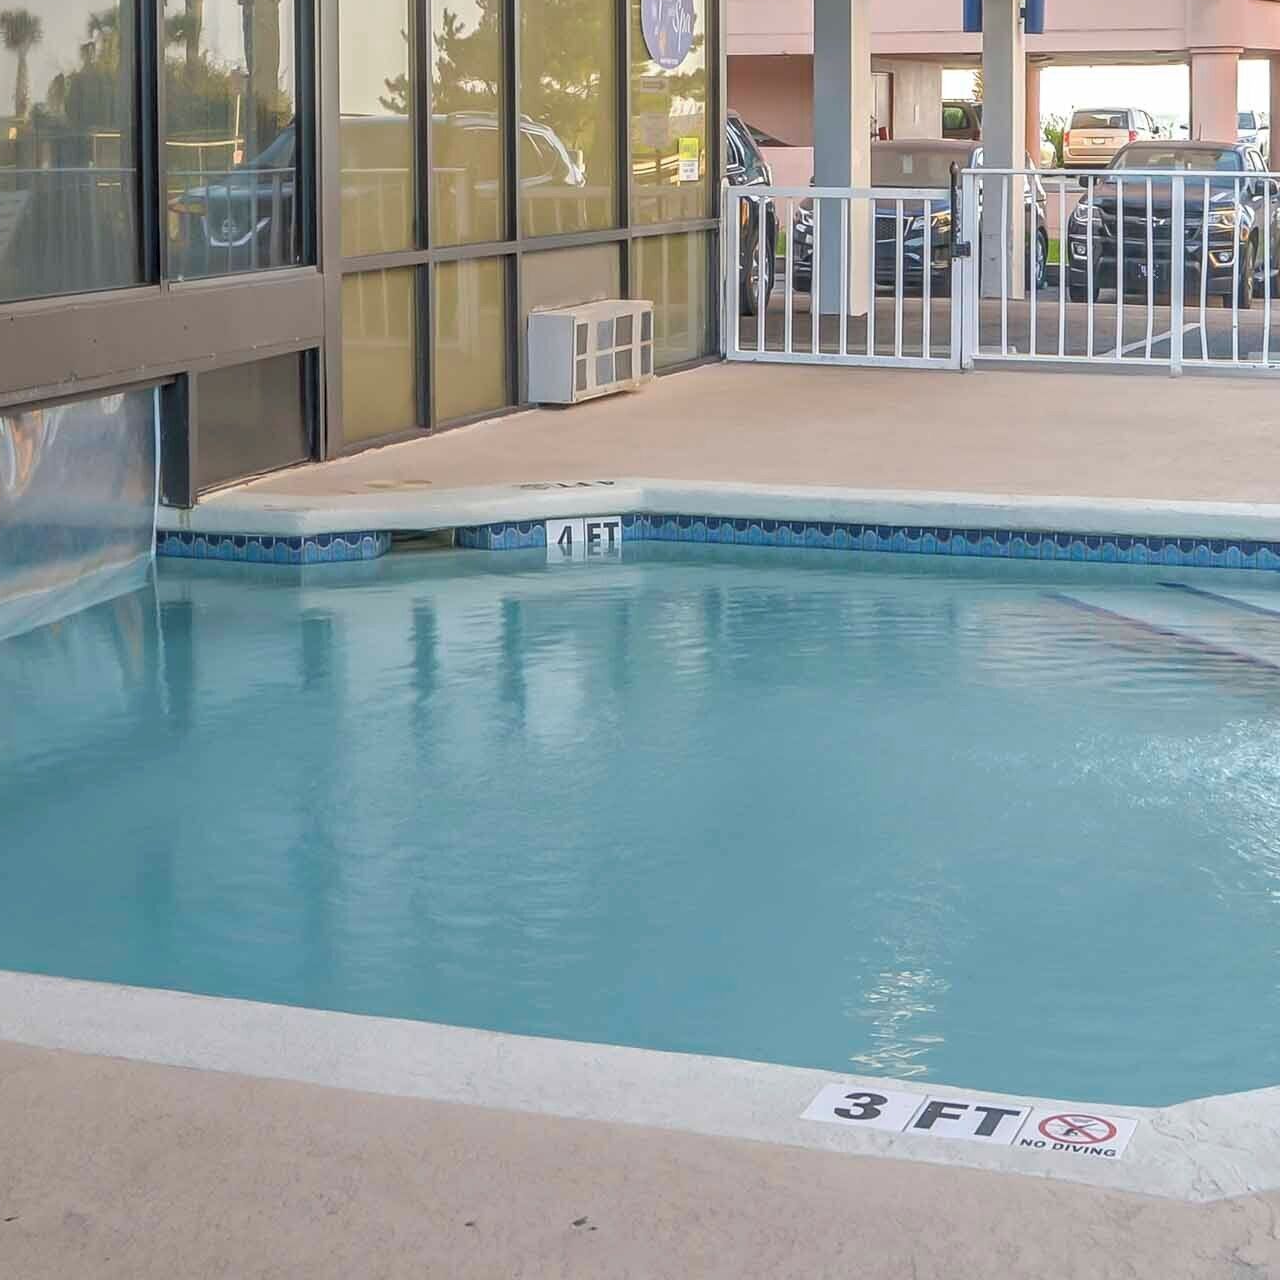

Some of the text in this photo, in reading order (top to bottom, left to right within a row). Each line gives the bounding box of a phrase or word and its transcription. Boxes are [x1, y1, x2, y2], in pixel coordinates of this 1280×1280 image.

[672, 0, 691, 52] Spa
[834, 1092, 1022, 1137] 3 FT
[1020, 1138, 1117, 1158] NO DIVING
